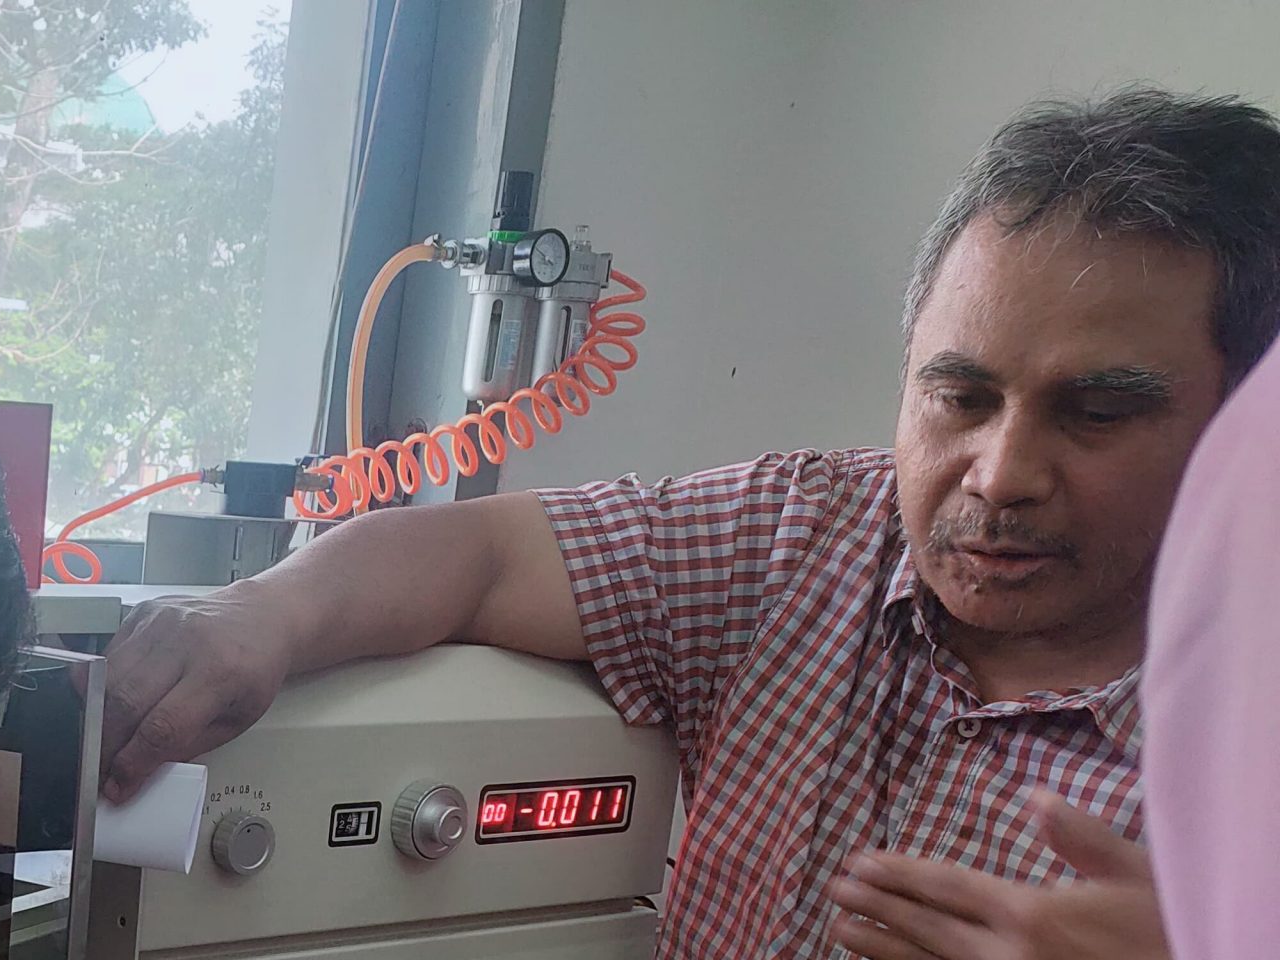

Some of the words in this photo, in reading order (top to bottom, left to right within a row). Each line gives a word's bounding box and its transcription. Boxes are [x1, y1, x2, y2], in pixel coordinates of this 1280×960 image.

[224, 785, 236, 796] 0.4
[239, 784, 250, 795] 0.8
[210, 792, 222, 802] 0.2
[260, 802, 271, 812] 2.5
